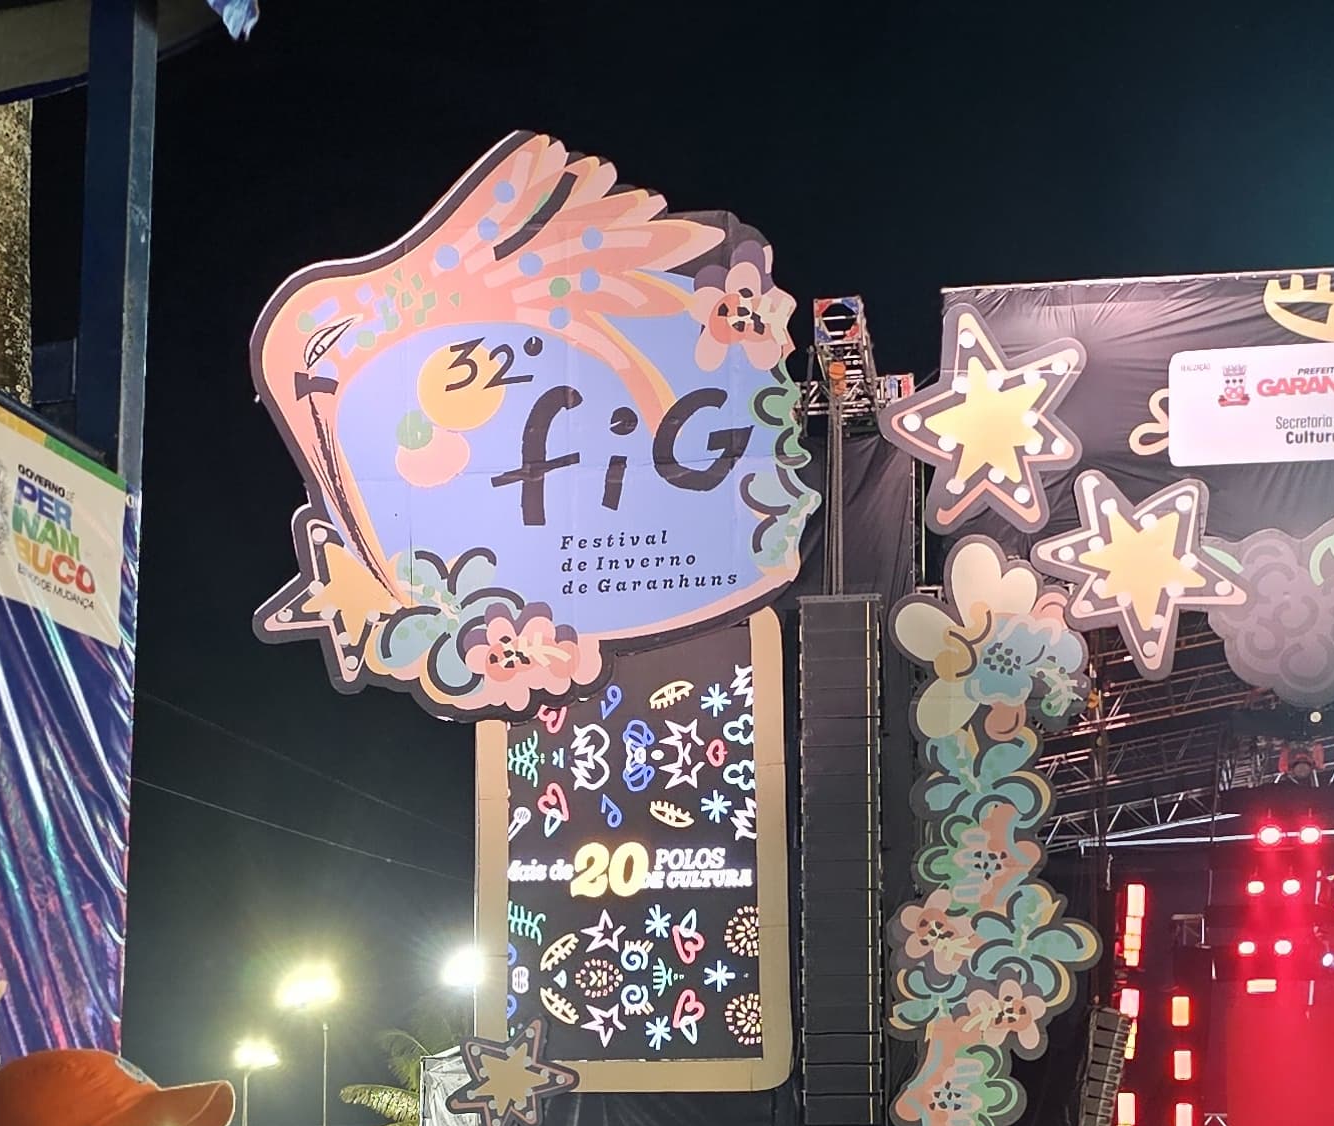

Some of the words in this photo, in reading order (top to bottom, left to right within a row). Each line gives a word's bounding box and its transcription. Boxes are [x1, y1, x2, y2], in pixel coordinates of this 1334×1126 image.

[18, 464, 65, 498] GOVERNO
[15, 476, 72, 531] PER
[12, 503, 81, 561] NAM
[560, 530, 668, 550] Festival
[14, 532, 96, 594] BUCO
[561, 558, 588, 572] de
[596, 553, 696, 571] Inverno
[562, 580, 588, 595] de
[597, 573, 738, 594] Garanhuns
[570, 841, 649, 898] 20
[654, 847, 726, 871] POLOS
[666, 868, 753, 889] CULTURA
